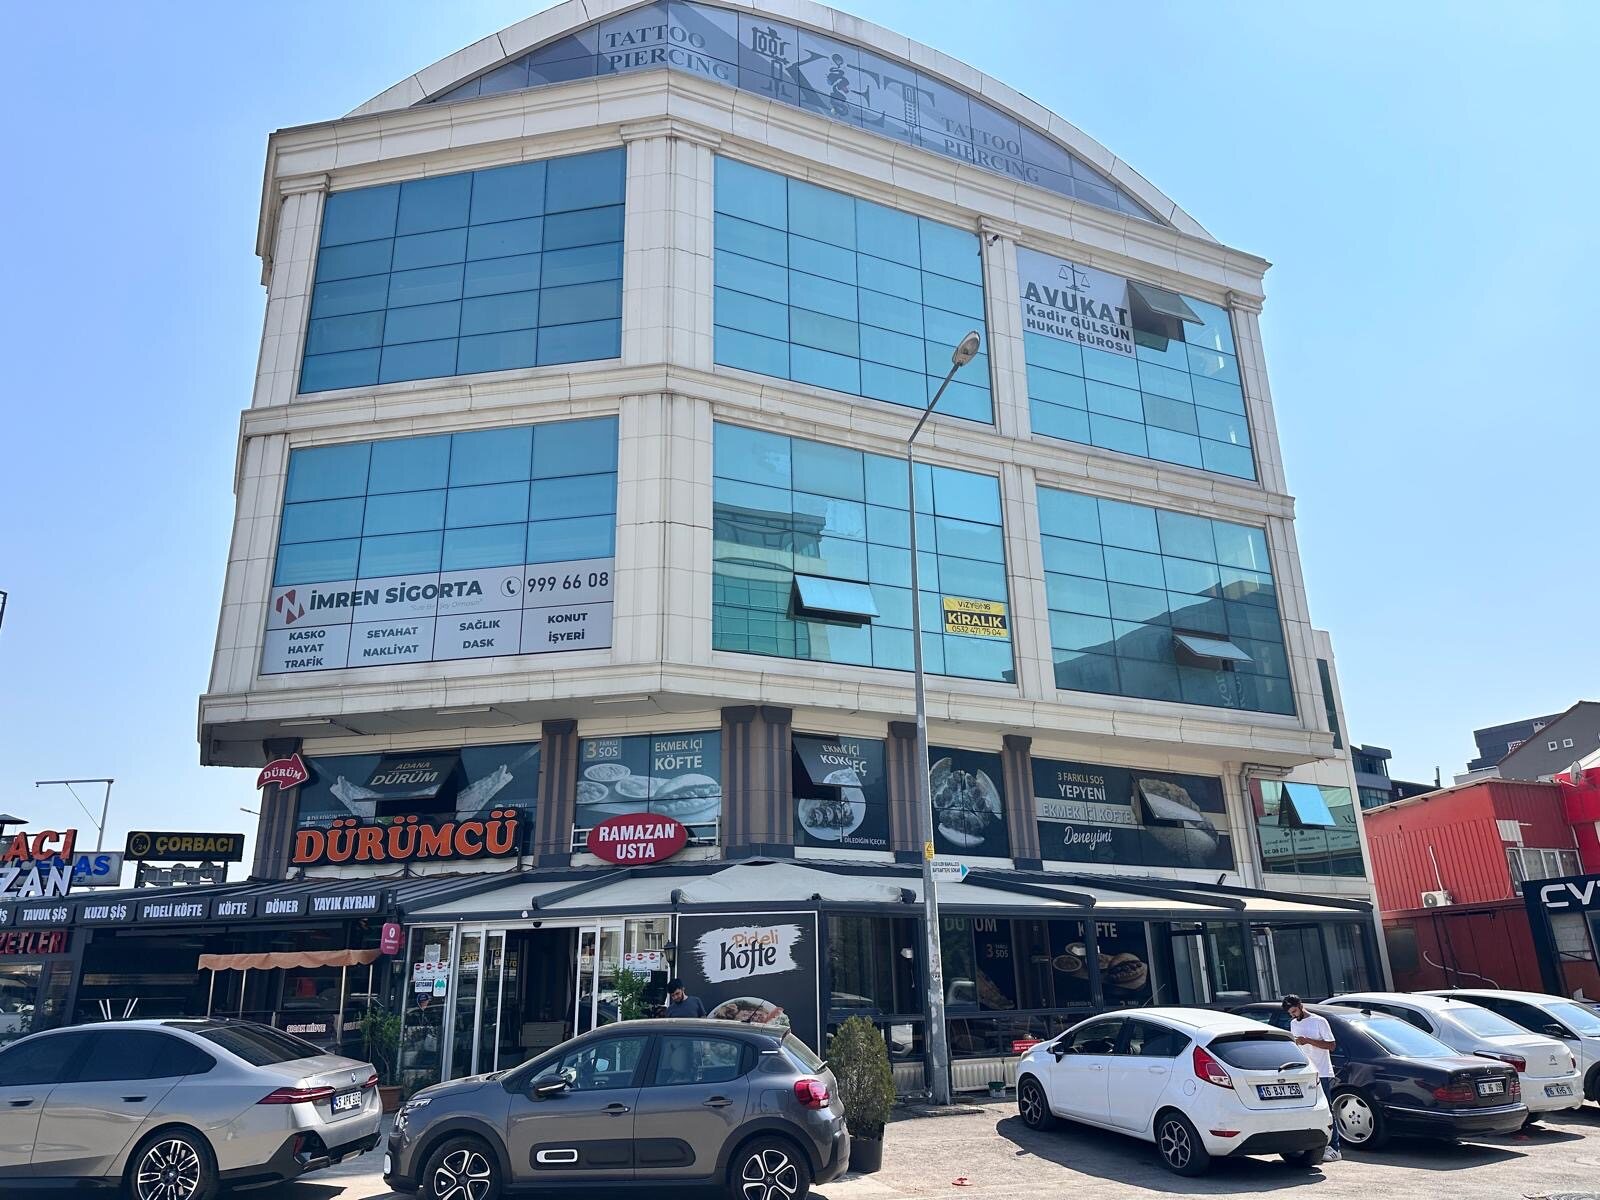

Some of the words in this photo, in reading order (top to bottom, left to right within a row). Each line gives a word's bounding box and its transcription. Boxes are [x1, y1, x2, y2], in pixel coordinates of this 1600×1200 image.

[606, 24, 706, 49] TATTOO
[609, 48, 729, 80] PIERCING
[941, 116, 1020, 156] TATTOO
[944, 138, 1040, 182] PIERCING
[1025, 281, 1128, 326] AVUKAT
[1026, 303, 1067, 325] Kadir
[1071, 315, 1131, 341] GÜLSÜN
[1026, 318, 1074, 339] HUKUK
[1077, 332, 1132, 354] BÜROSU
[527, 576, 557, 593] 999
[562, 574, 582, 590] 66
[588, 572, 609, 588] 08
[310, 589, 379, 611] İMREN
[385, 580, 483, 604] SİGORTA
[459, 619, 500, 632] SAĞLIK
[547, 612, 588, 624] KONUT
[289, 630, 326, 641] KASKO
[367, 627, 419, 639] SEYAHAT
[549, 628, 585, 645] İŞYERİ
[287, 643, 324, 655] HAYAT
[363, 644, 419, 657] NAKLİYAT
[462, 638, 495, 649] DASK
[284, 655, 324, 669] TRAFİK
[586, 741, 597, 759] 3
[599, 746, 618, 758] SOS
[655, 740, 688, 752] EKMEK
[690, 738, 703, 753] İÇİ
[395, 761, 432, 770] ADANA
[655, 754, 703, 771] KÖFTE
[263, 766, 302, 781] DÜRÜM
[369, 769, 440, 786] DÜRÜM
[1057, 771, 1062, 781] 3
[1063, 772, 1089, 784] FARKLI
[1089, 775, 1104, 785] SOS
[1058, 784, 1106, 801] YEPYENİ
[1043, 803, 1080, 819] EKMEK
[292, 809, 519, 864] DÜRÜMCÜ
[598, 823, 675, 842] RAMAZAN
[1063, 825, 1112, 850] Deneyimi
[156, 836, 234, 855] ÇORBACI
[616, 842, 656, 860] USTA
[313, 896, 342, 911] YAYIK
[342, 895, 376, 910] AYRAN
[1541, 881, 1600, 908] CV
[23, 908, 52, 921] TAVUK
[52, 906, 68, 923] ŞİŞ
[84, 905, 109, 919] KUZU
[110, 904, 127, 921] ŞİŞ
[143, 903, 173, 918] PİDELİ
[173, 902, 203, 918] KÖFTE
[218, 902, 247, 916] KÖFTE
[265, 899, 299, 914] DÖNER
[1077, 921, 1118, 938] KFTE
[732, 929, 779, 949] Pideli
[719, 940, 777, 975] Köfte
[995, 949, 1009, 958] SOS
[1263, 1086, 1272, 1097] 16
